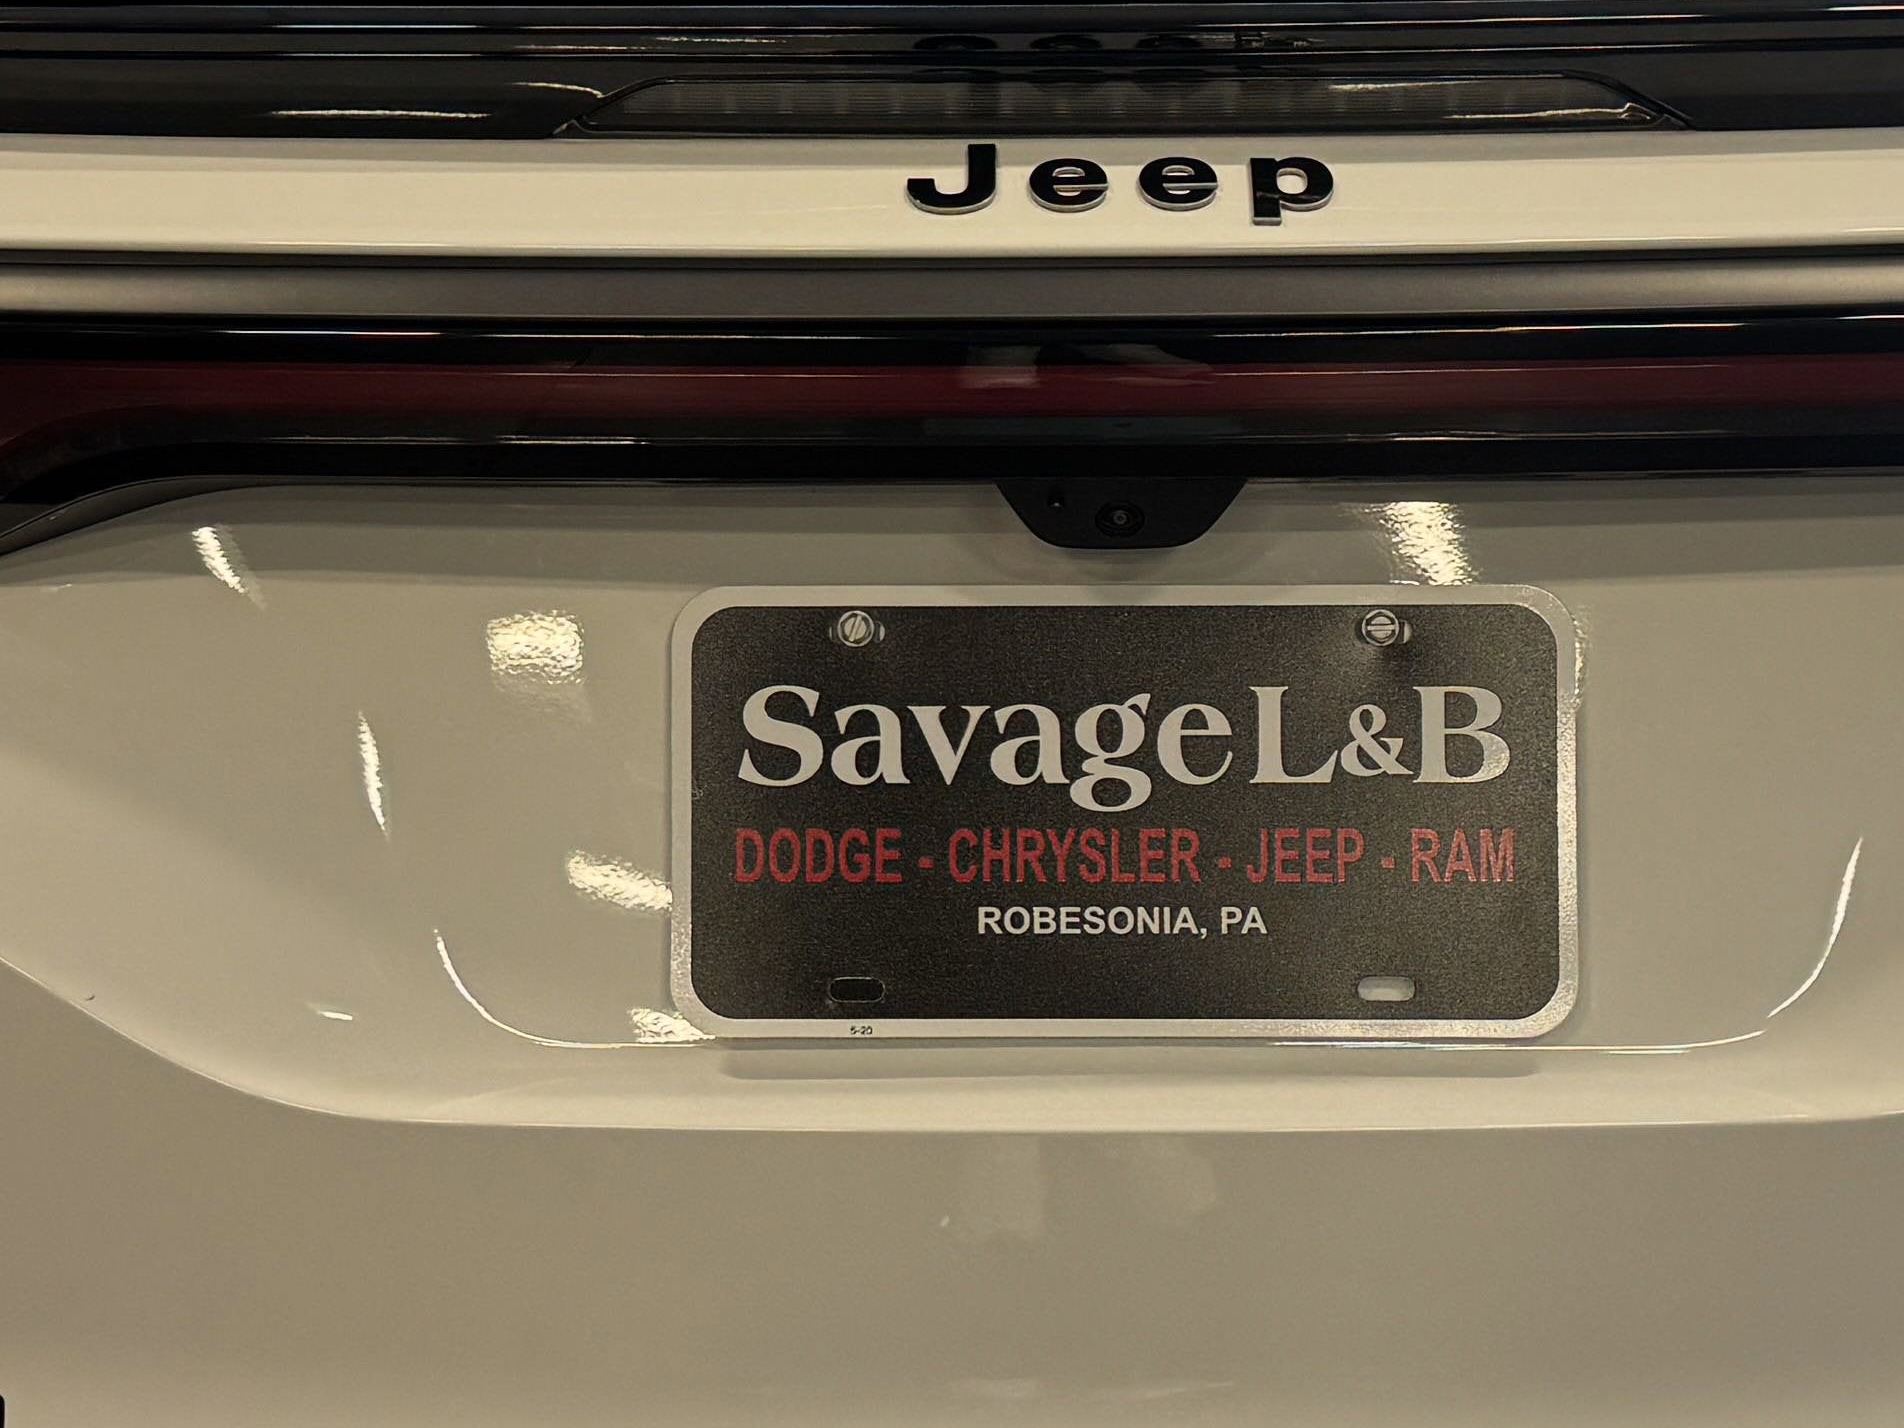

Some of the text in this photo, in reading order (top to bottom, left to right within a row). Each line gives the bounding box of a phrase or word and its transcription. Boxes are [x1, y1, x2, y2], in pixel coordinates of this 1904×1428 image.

[907, 143, 1335, 226] Jeep
[735, 828, 902, 883] DODGE
[949, 828, 1201, 883] CHRYSLER
[1246, 828, 1365, 883] JEEP
[1410, 828, 1517, 883] RAM
[978, 906, 1267, 939] ROBESONIA, PA
